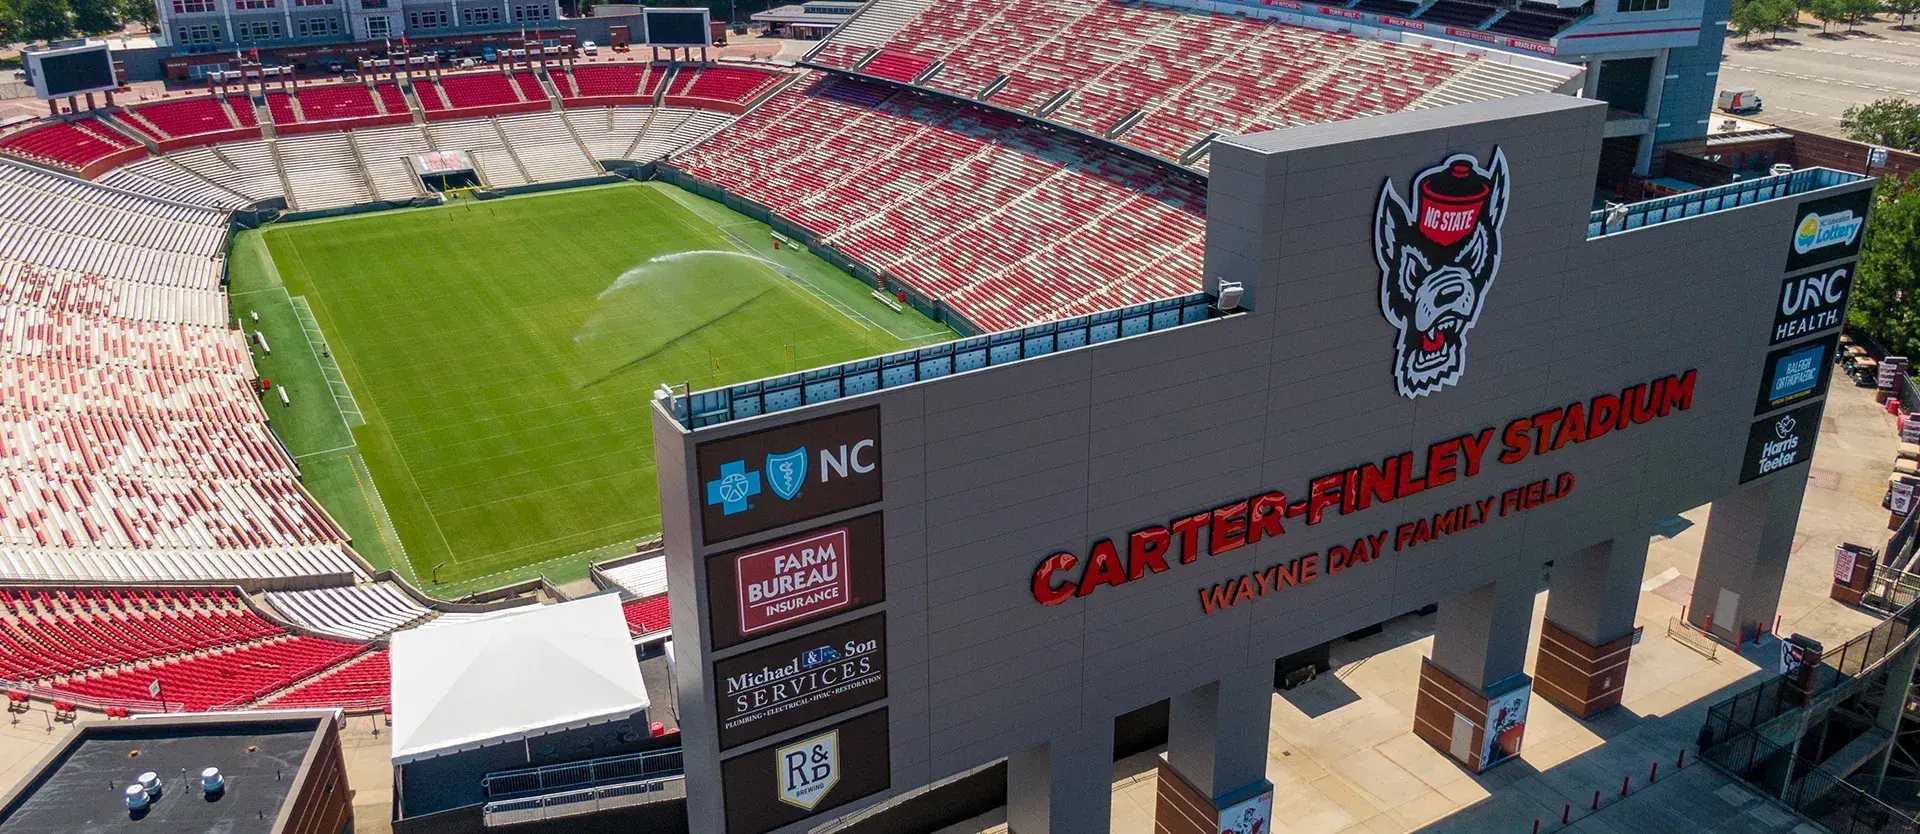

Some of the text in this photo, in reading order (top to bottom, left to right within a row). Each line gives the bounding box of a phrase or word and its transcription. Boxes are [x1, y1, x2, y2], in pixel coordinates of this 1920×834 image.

[1389, 19, 1423, 30] PHILIP RIVERS
[1514, 39, 1536, 51] BRADLEY
[1424, 206, 1475, 232] NC STATE
[1816, 222, 1859, 243] Lottery
[1782, 268, 1847, 316] UNC
[1776, 309, 1837, 341] HEALTH
[1775, 367, 1816, 391] ORTHOPAEDIC
[1785, 357, 1812, 375] RALEIGH
[820, 439, 875, 483] NC
[1762, 434, 1799, 459] Harris
[1759, 450, 1797, 475] Teeter
[1031, 368, 1698, 607] CARTER-FINLEY STADIUM
[1199, 471, 1576, 616] WAYNE DAY FAMILY FIELD
[774, 543, 837, 575] FARM
[748, 561, 838, 603] BUREAU
[766, 587, 839, 617] INSURANCE
[727, 638, 878, 694] Michael & Son
[736, 656, 871, 713] SERVICES
[796, 783, 825, 798] BREWING
